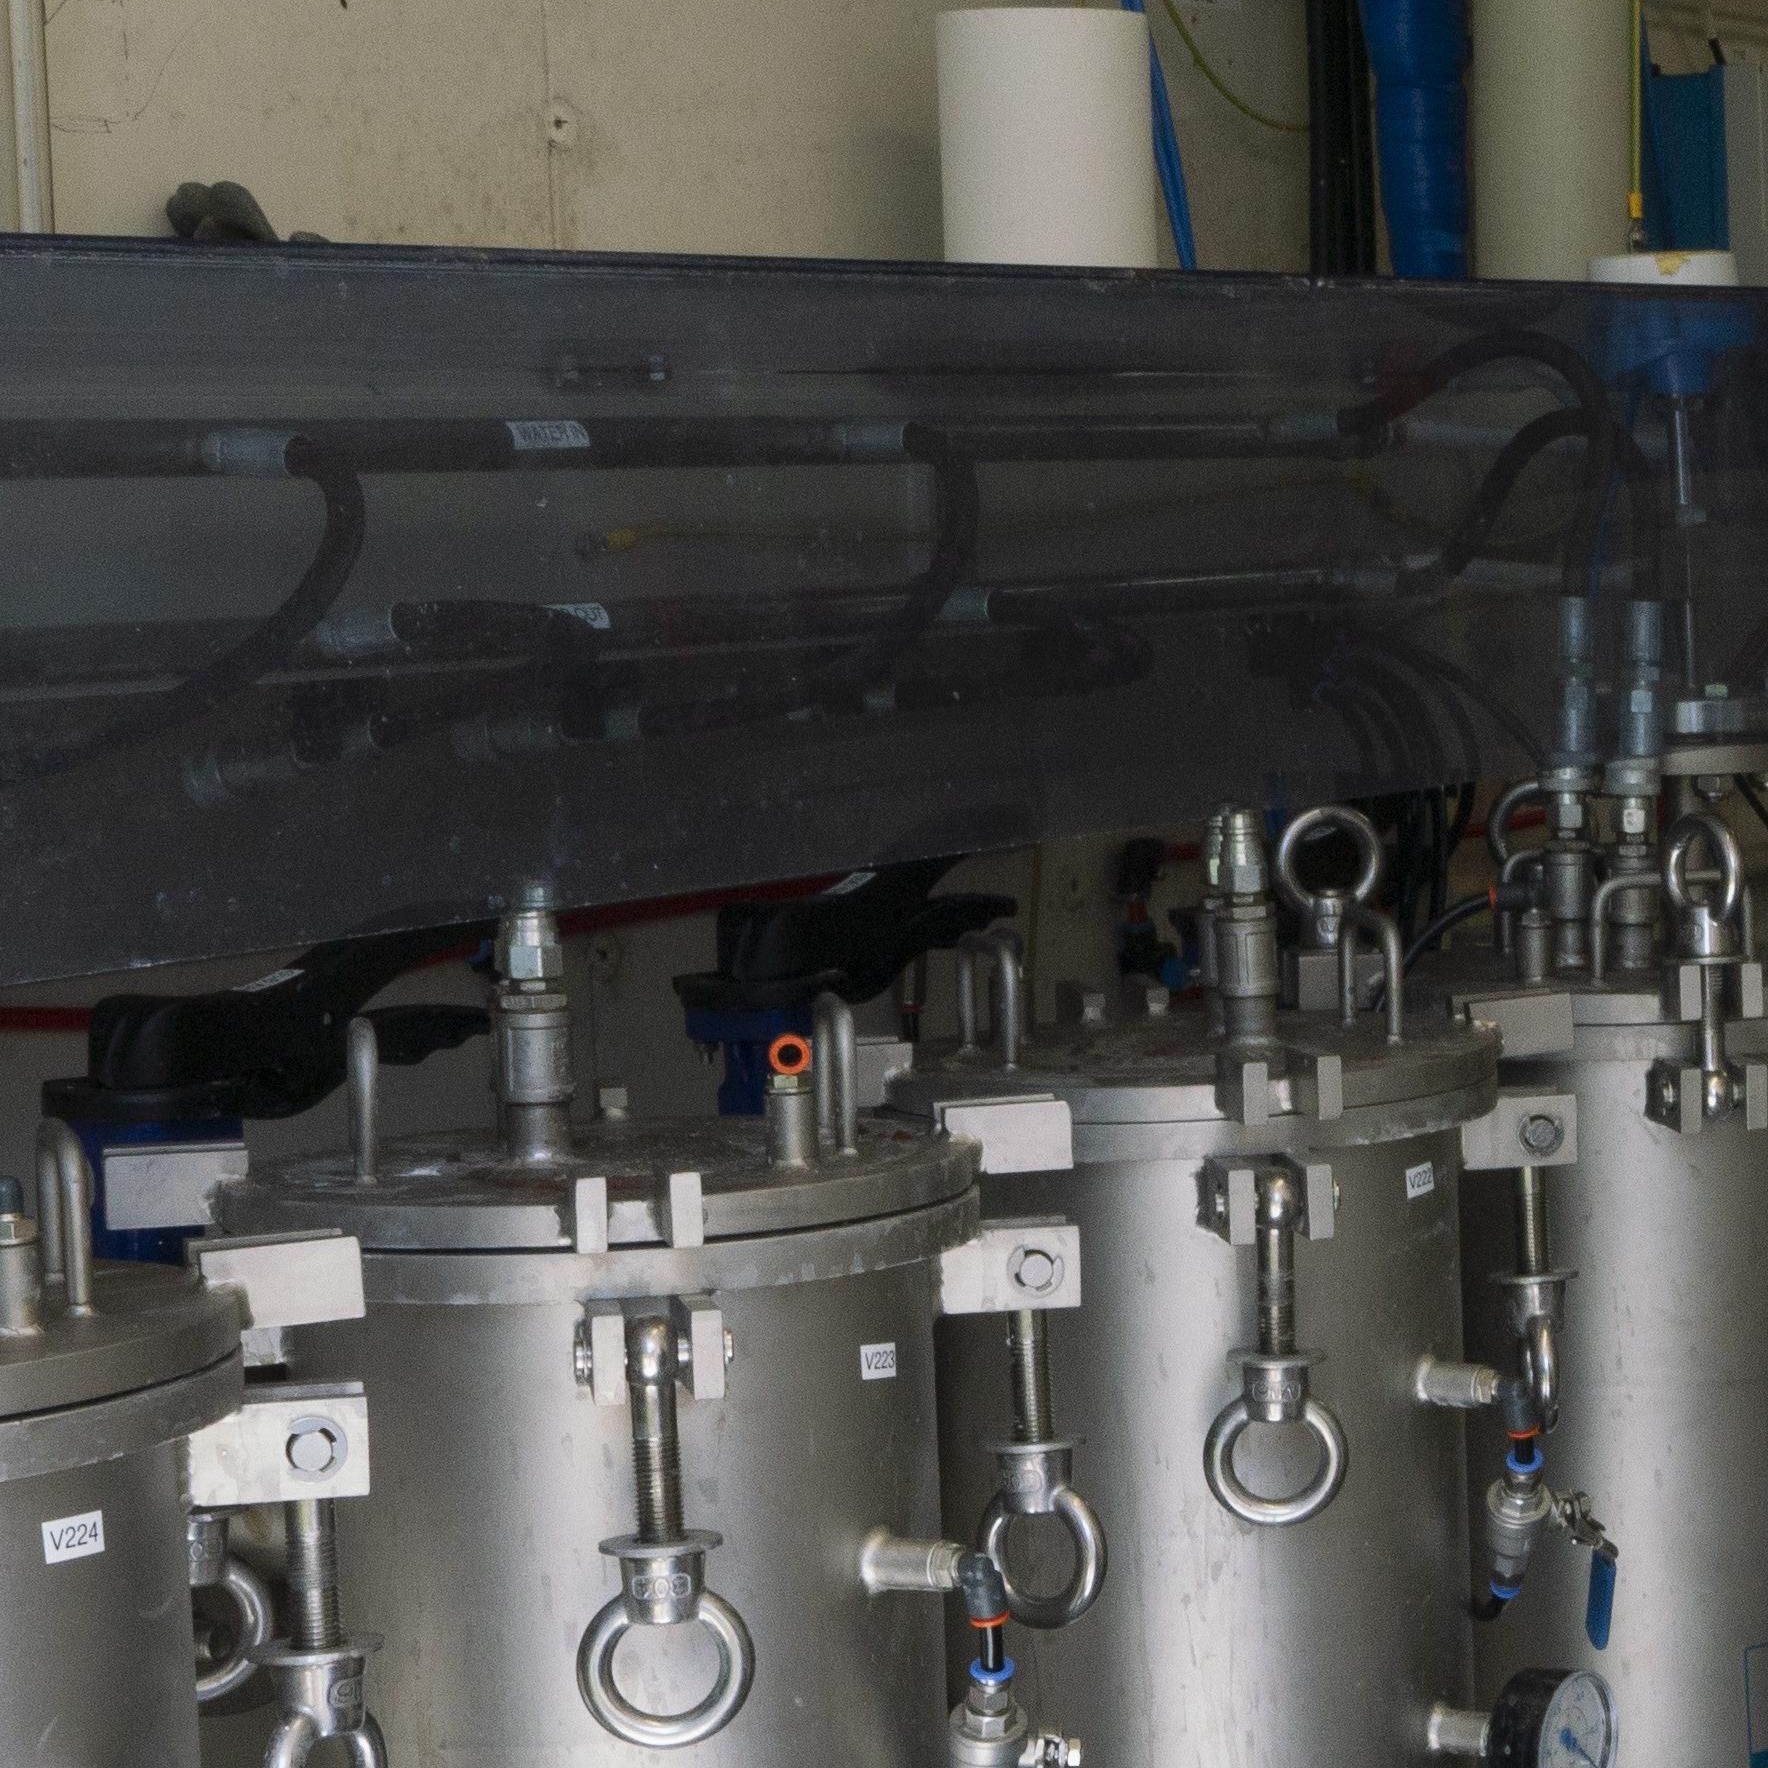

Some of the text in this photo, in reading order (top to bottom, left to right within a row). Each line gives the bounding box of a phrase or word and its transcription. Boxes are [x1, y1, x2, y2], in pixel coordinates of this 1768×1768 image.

[517, 423, 568, 442] WATER
[1409, 1166, 1433, 1189] V222
[865, 1350, 895, 1370] V223
[49, 1521, 99, 1551] V224
